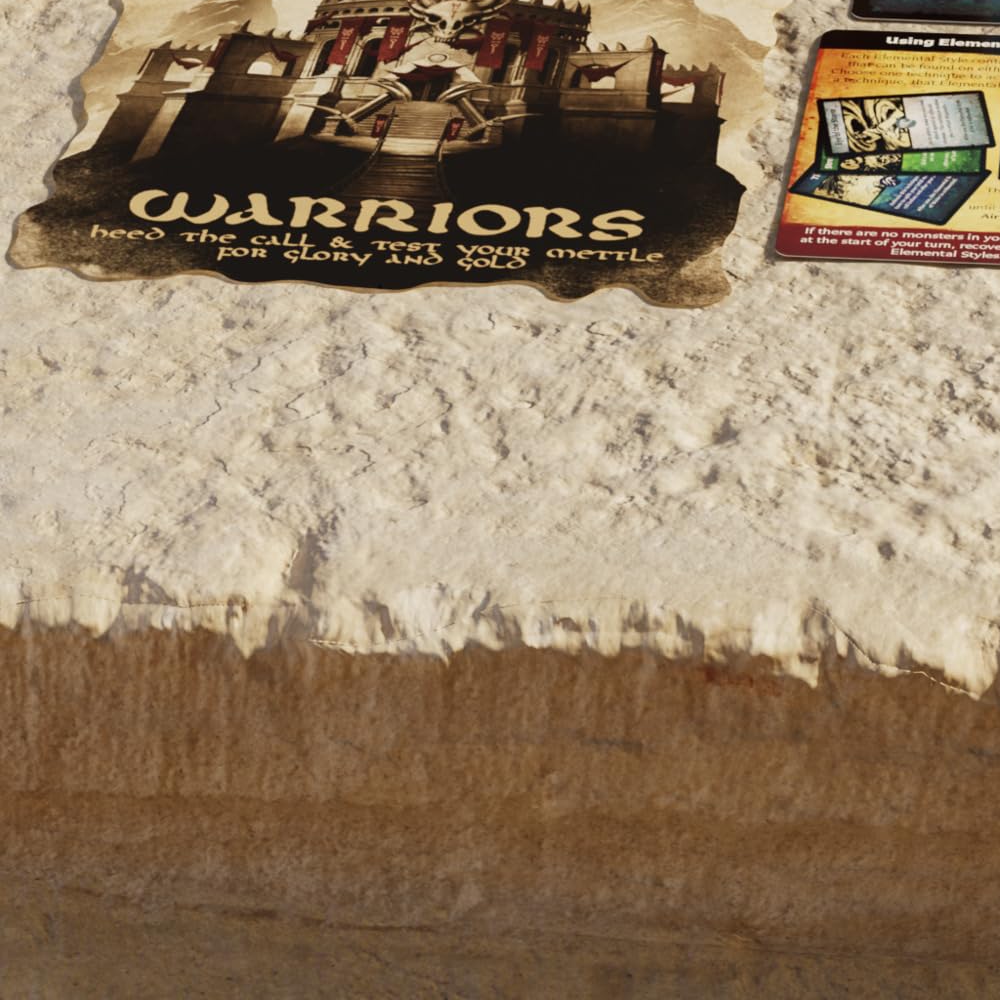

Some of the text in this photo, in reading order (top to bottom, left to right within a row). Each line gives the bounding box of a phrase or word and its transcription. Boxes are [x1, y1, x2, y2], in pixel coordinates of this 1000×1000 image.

[885, 36, 935, 47] Using
[804, 227, 816, 235] If
[818, 227, 853, 236] there
[856, 229, 878, 237] are
[881, 230, 898, 238] no
[902, 230, 964, 240] monsters
[967, 232, 980, 241] in
[329, 235, 353, 249] &
[816, 236, 838, 245] the
[841, 237, 871, 246] start
[874, 238, 890, 246] of
[891, 240, 921, 249] your
[924, 240, 955, 249] turn,
[890, 248, 957, 258] Elemental
